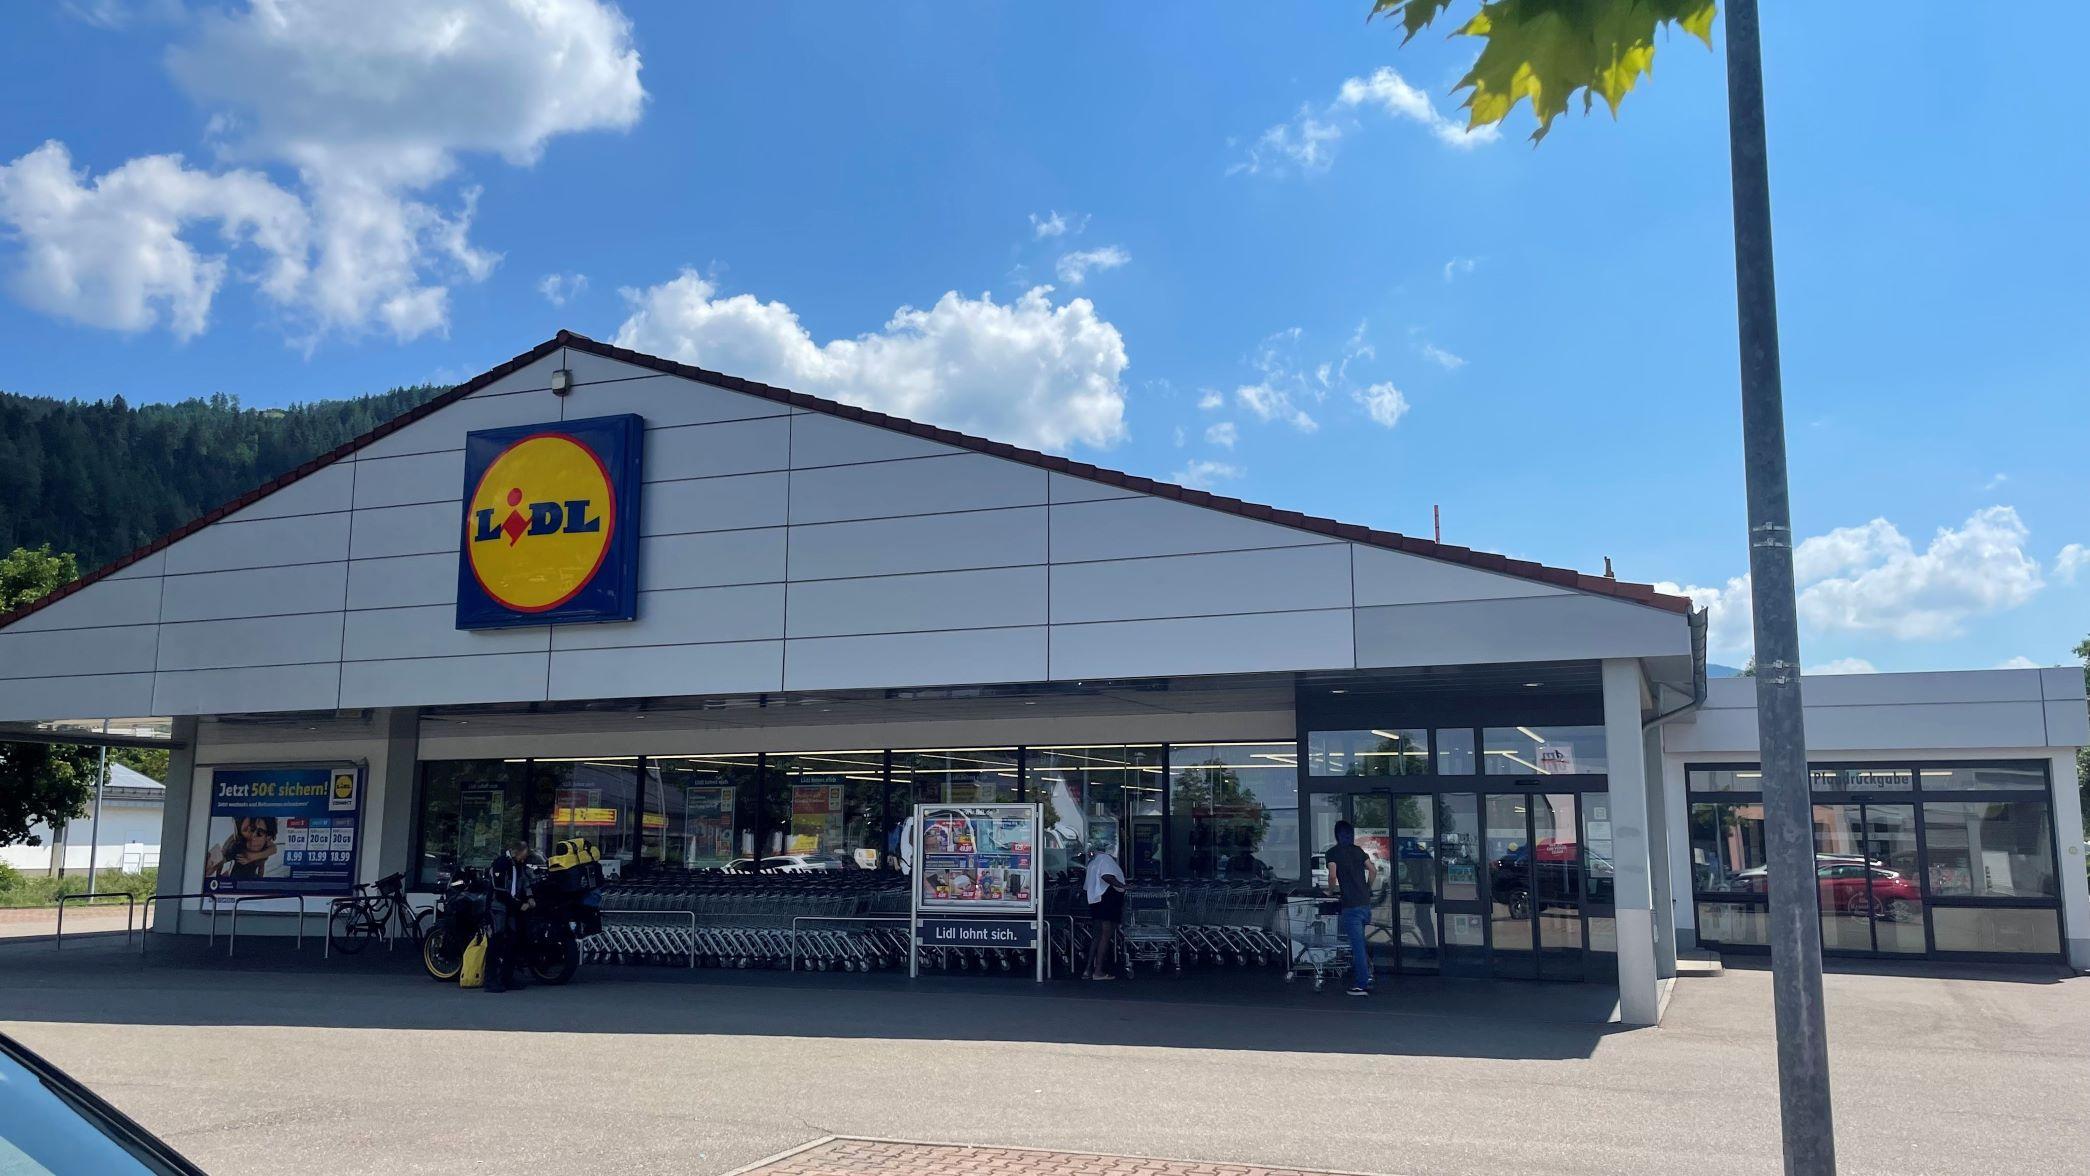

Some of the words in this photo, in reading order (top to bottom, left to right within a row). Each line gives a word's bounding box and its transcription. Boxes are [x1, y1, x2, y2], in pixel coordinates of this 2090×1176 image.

[1814, 772, 1909, 787] Pfandrückgabe
[219, 783, 250, 796] Jetzt
[251, 782, 276, 796] 50€
[278, 781, 329, 796] sichern!
[288, 835, 296, 843] 10
[310, 834, 319, 843] 20
[333, 834, 342, 843] 30
[287, 852, 303, 861] 8.99
[308, 851, 327, 861] 13.99
[331, 851, 350, 862] 18.99
[936, 927, 956, 939] Lidl
[960, 927, 988, 940] lohnt
[991, 928, 1017, 940] sich.
